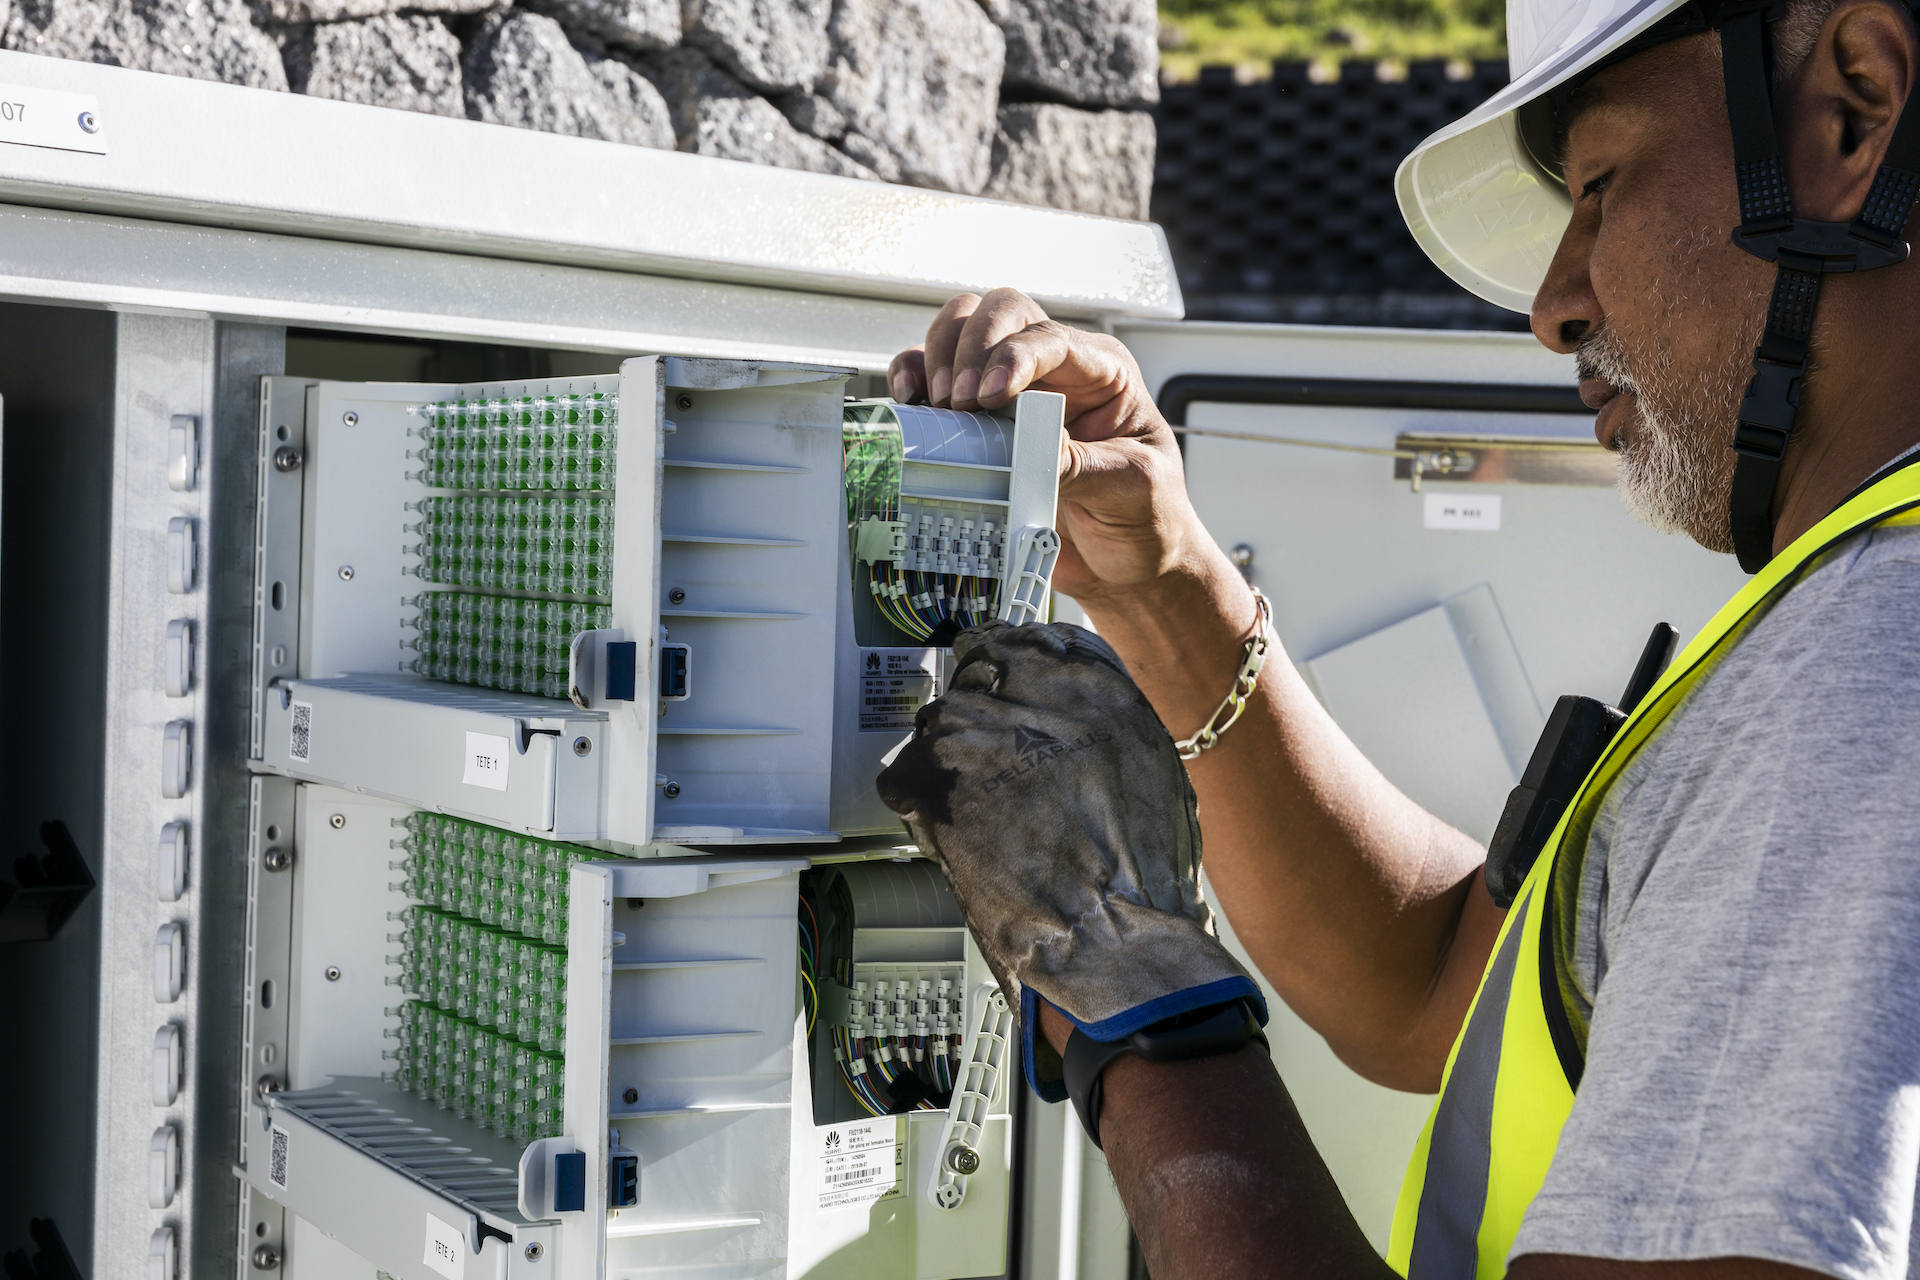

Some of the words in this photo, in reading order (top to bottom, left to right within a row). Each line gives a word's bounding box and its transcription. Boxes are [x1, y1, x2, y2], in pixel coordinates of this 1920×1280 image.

[0, 101, 25, 122] 07
[476, 755, 491, 769] TETE
[494, 759, 498, 770] 1
[435, 1239, 448, 1259] TETE
[450, 1250, 455, 1262] 2
